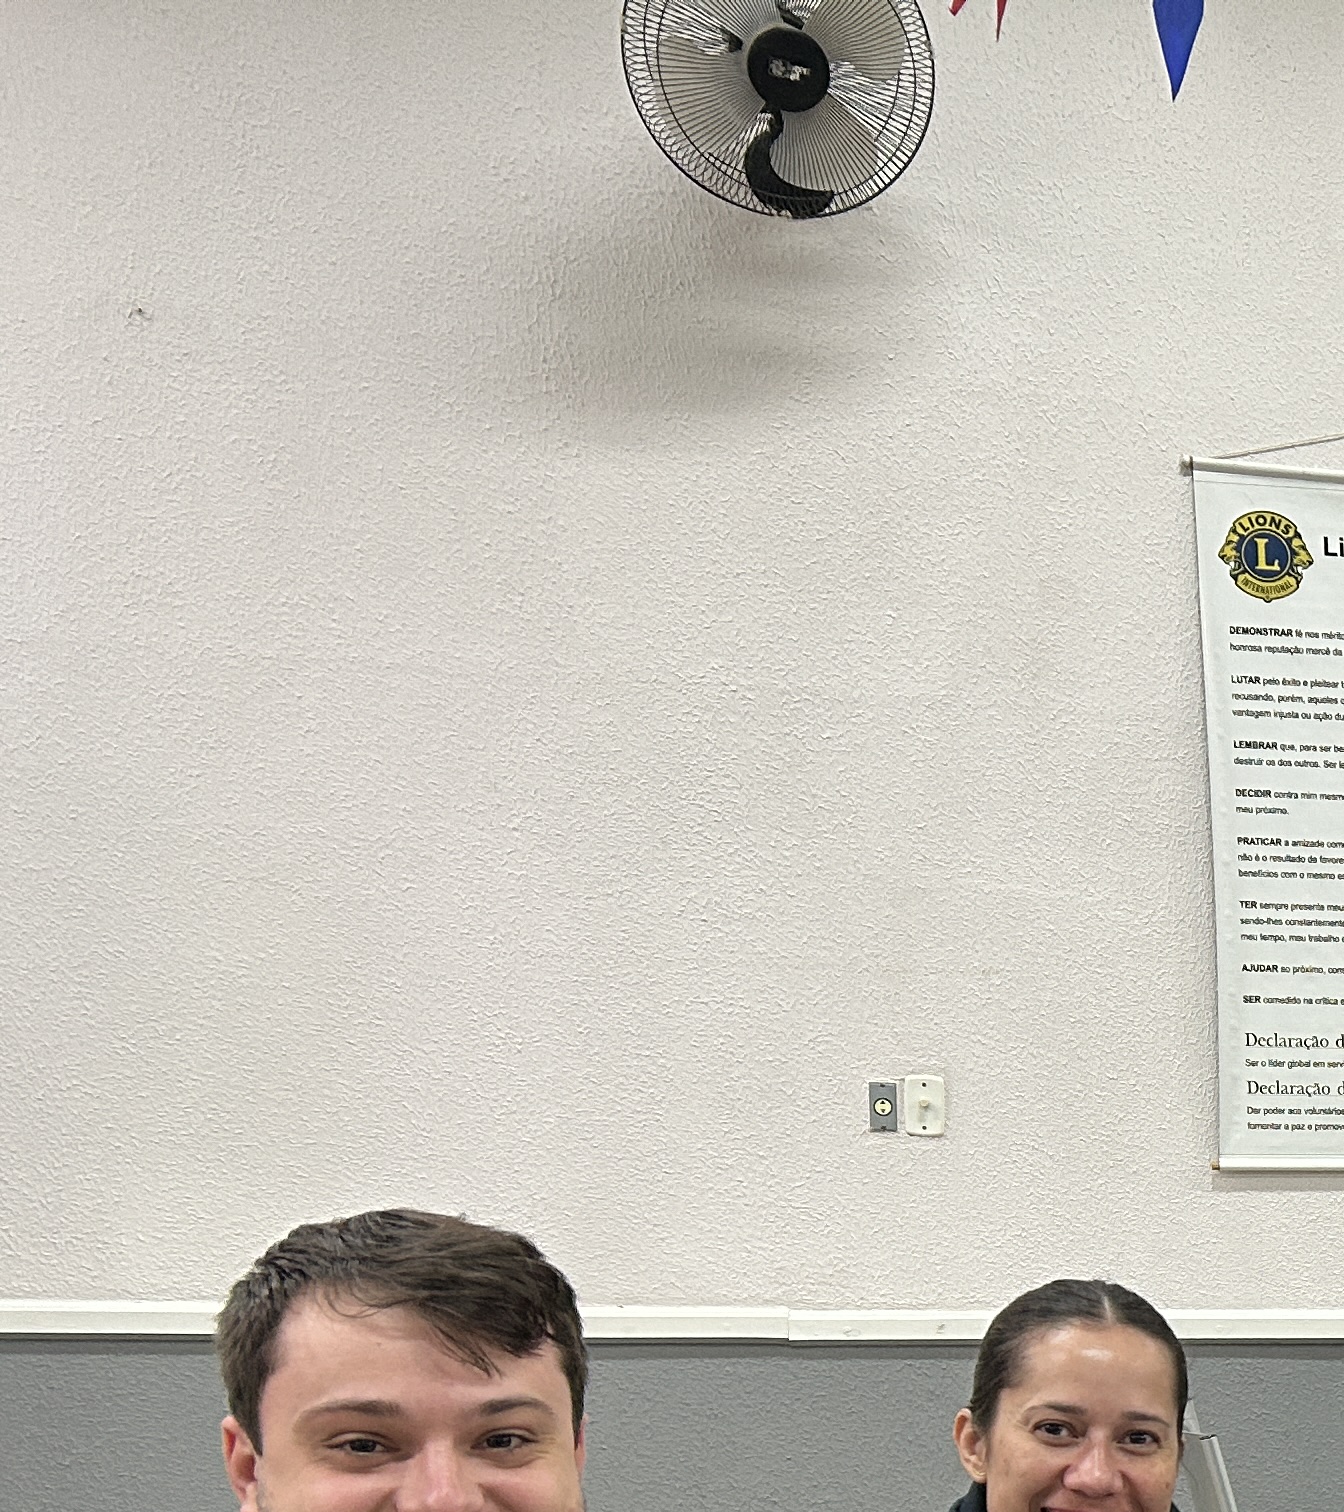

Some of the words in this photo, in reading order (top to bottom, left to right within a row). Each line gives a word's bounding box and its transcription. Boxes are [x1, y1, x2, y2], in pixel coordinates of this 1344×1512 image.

[1238, 514, 1293, 536] LIONS
[1254, 538, 1280, 571] L
[1245, 1032, 1329, 1050] Declaração
[1247, 1080, 1331, 1097] Declaração
